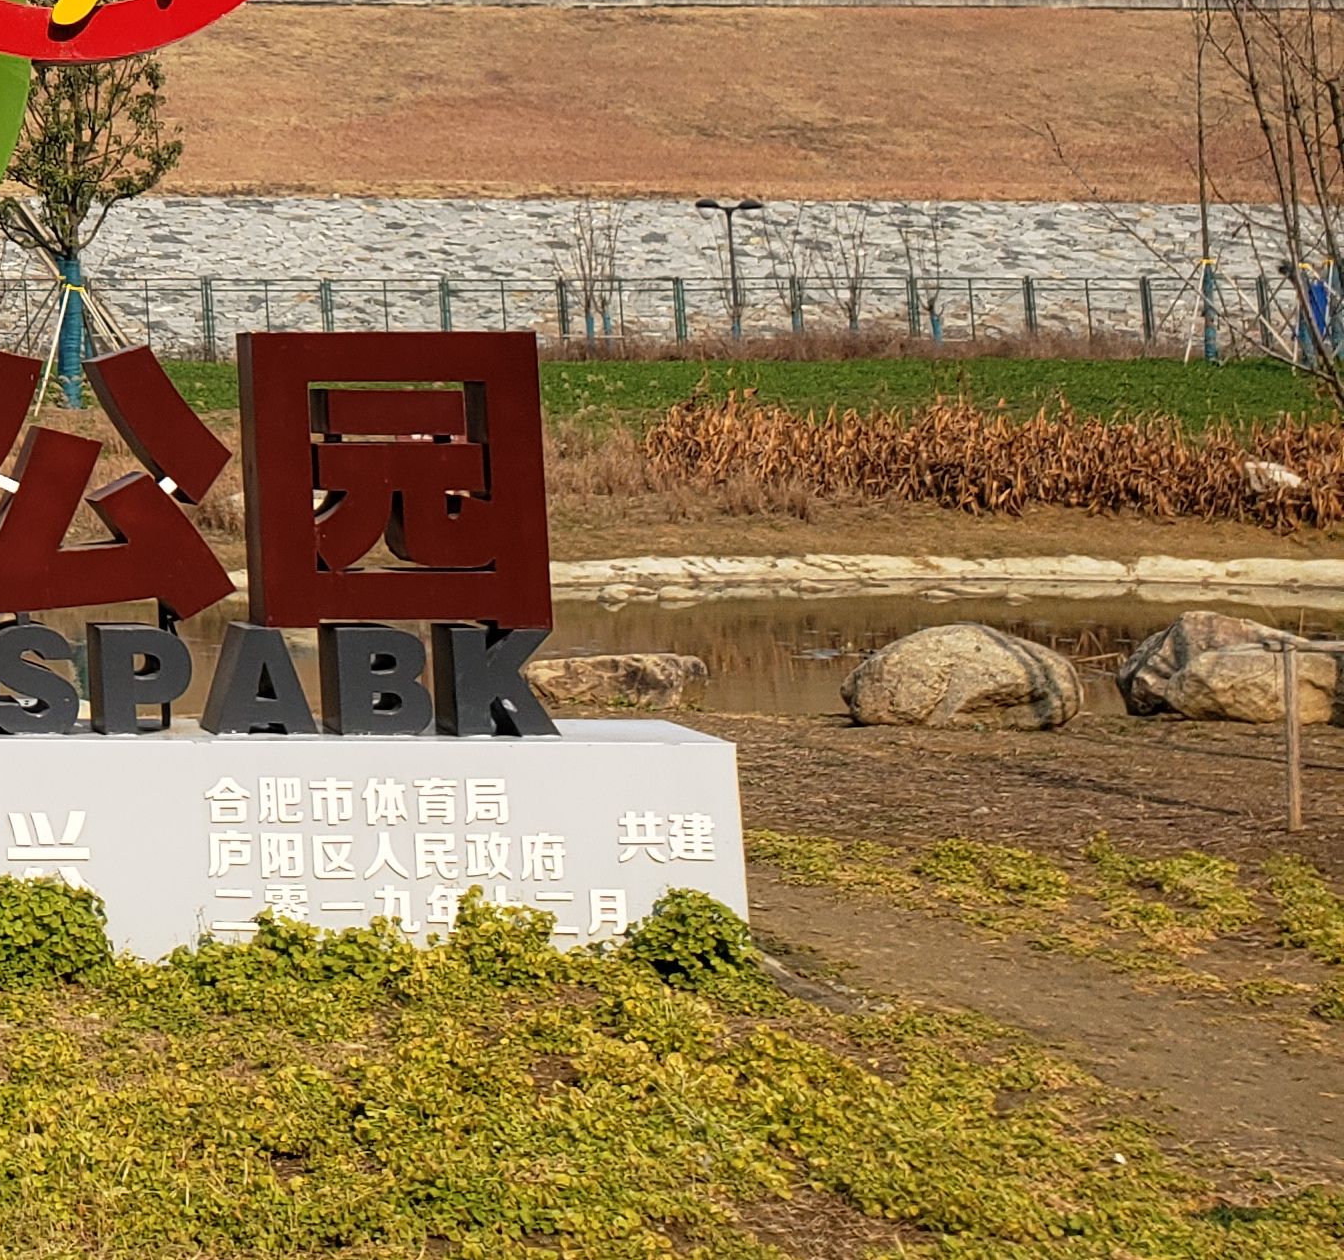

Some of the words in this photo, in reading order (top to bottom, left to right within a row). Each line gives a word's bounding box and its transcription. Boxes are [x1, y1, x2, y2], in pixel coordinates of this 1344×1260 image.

[204, 776, 510, 826] 合肥市体育局
[207, 830, 567, 881] 庐阳区人民政府
[617, 810, 717, 863] 共建
